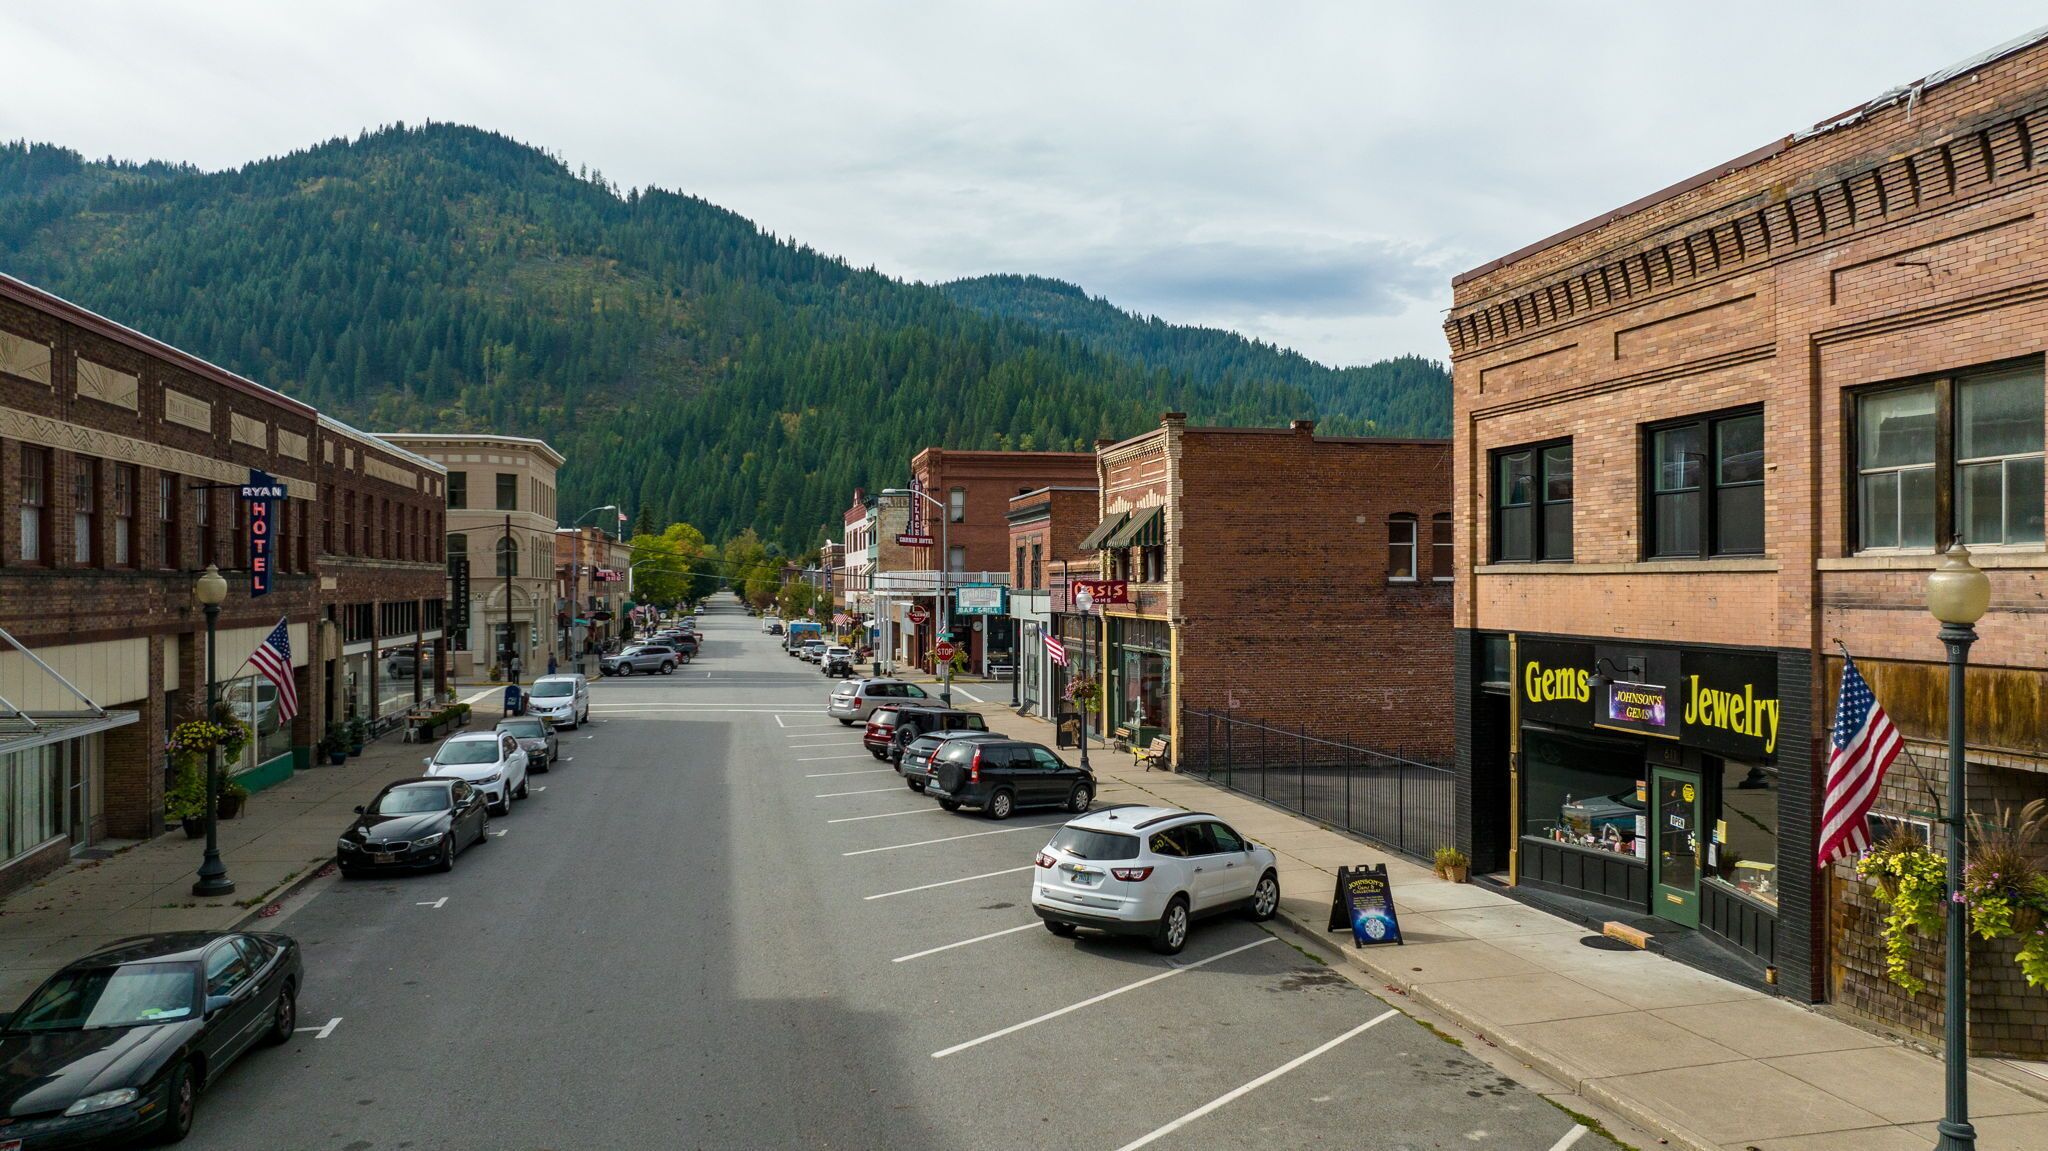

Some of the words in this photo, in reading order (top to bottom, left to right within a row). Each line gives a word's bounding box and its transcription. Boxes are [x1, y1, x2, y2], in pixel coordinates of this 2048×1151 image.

[243, 487, 282, 497] RYAN
[253, 502, 267, 590] HOTEL
[937, 648, 953, 656] STOP
[1525, 660, 1590, 702] Gems
[1614, 690, 1662, 707] JOHNSON'S
[1626, 706, 1650, 721] GEMS
[1684, 675, 1779, 754] Jewelry
[1672, 816, 1683, 828] OPEN
[1348, 879, 1384, 889] JOHNSON'S
